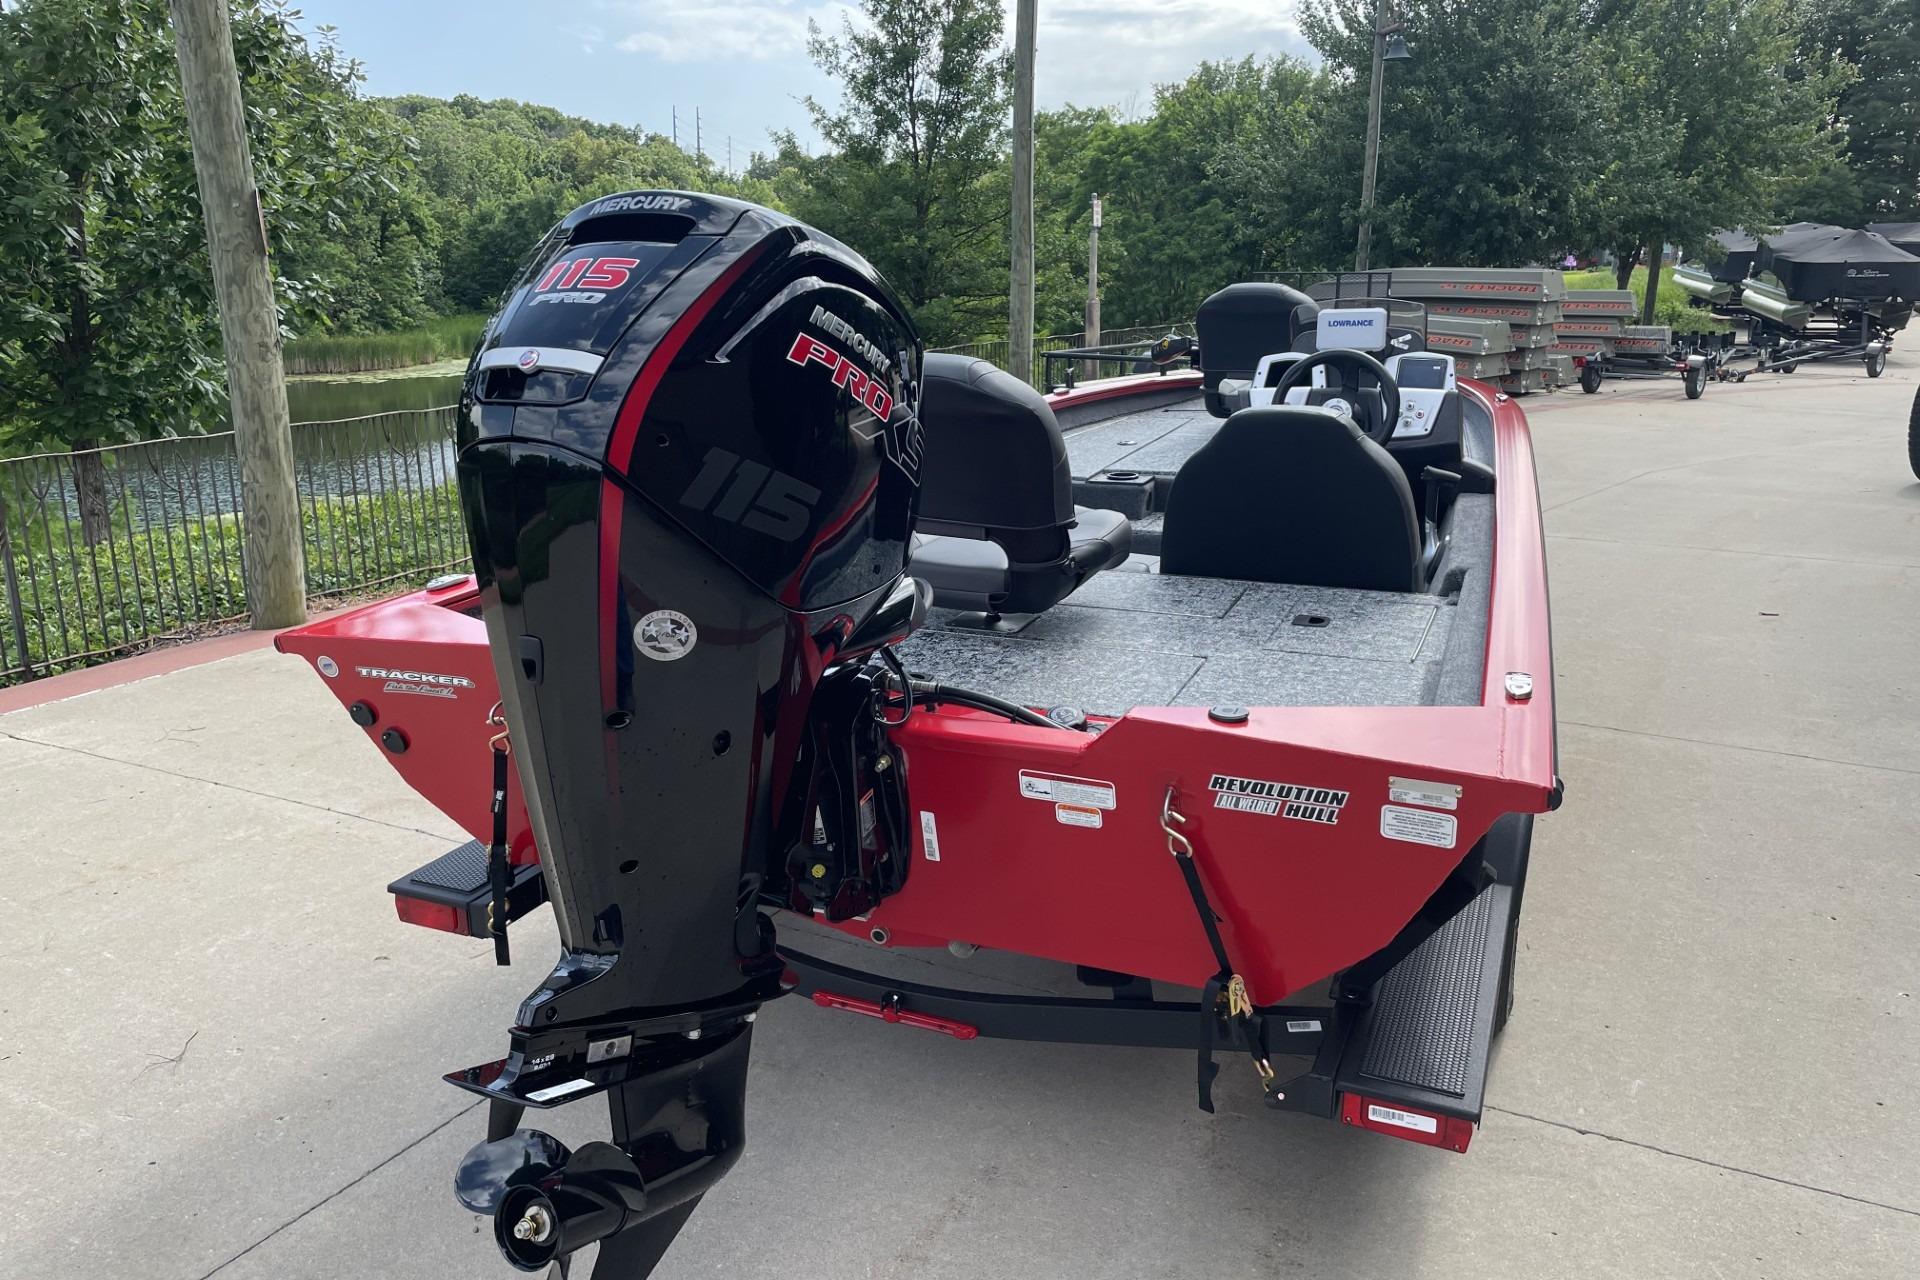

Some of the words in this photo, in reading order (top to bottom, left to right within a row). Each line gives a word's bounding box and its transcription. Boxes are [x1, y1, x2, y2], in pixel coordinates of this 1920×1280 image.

[589, 195, 690, 215] MERCURY
[534, 257, 640, 292] 115
[528, 291, 607, 306] PRO
[1328, 319, 1375, 328] LOWRANCE
[809, 304, 890, 371] MERCURY
[786, 332, 893, 422] PRO
[678, 446, 822, 542] 115
[357, 667, 470, 686] TRACKER
[1211, 776, 1347, 806] REVOLUTION
[1219, 794, 1235, 808] ALL
[1238, 797, 1277, 813] WELDED
[1284, 802, 1338, 823] HULL
